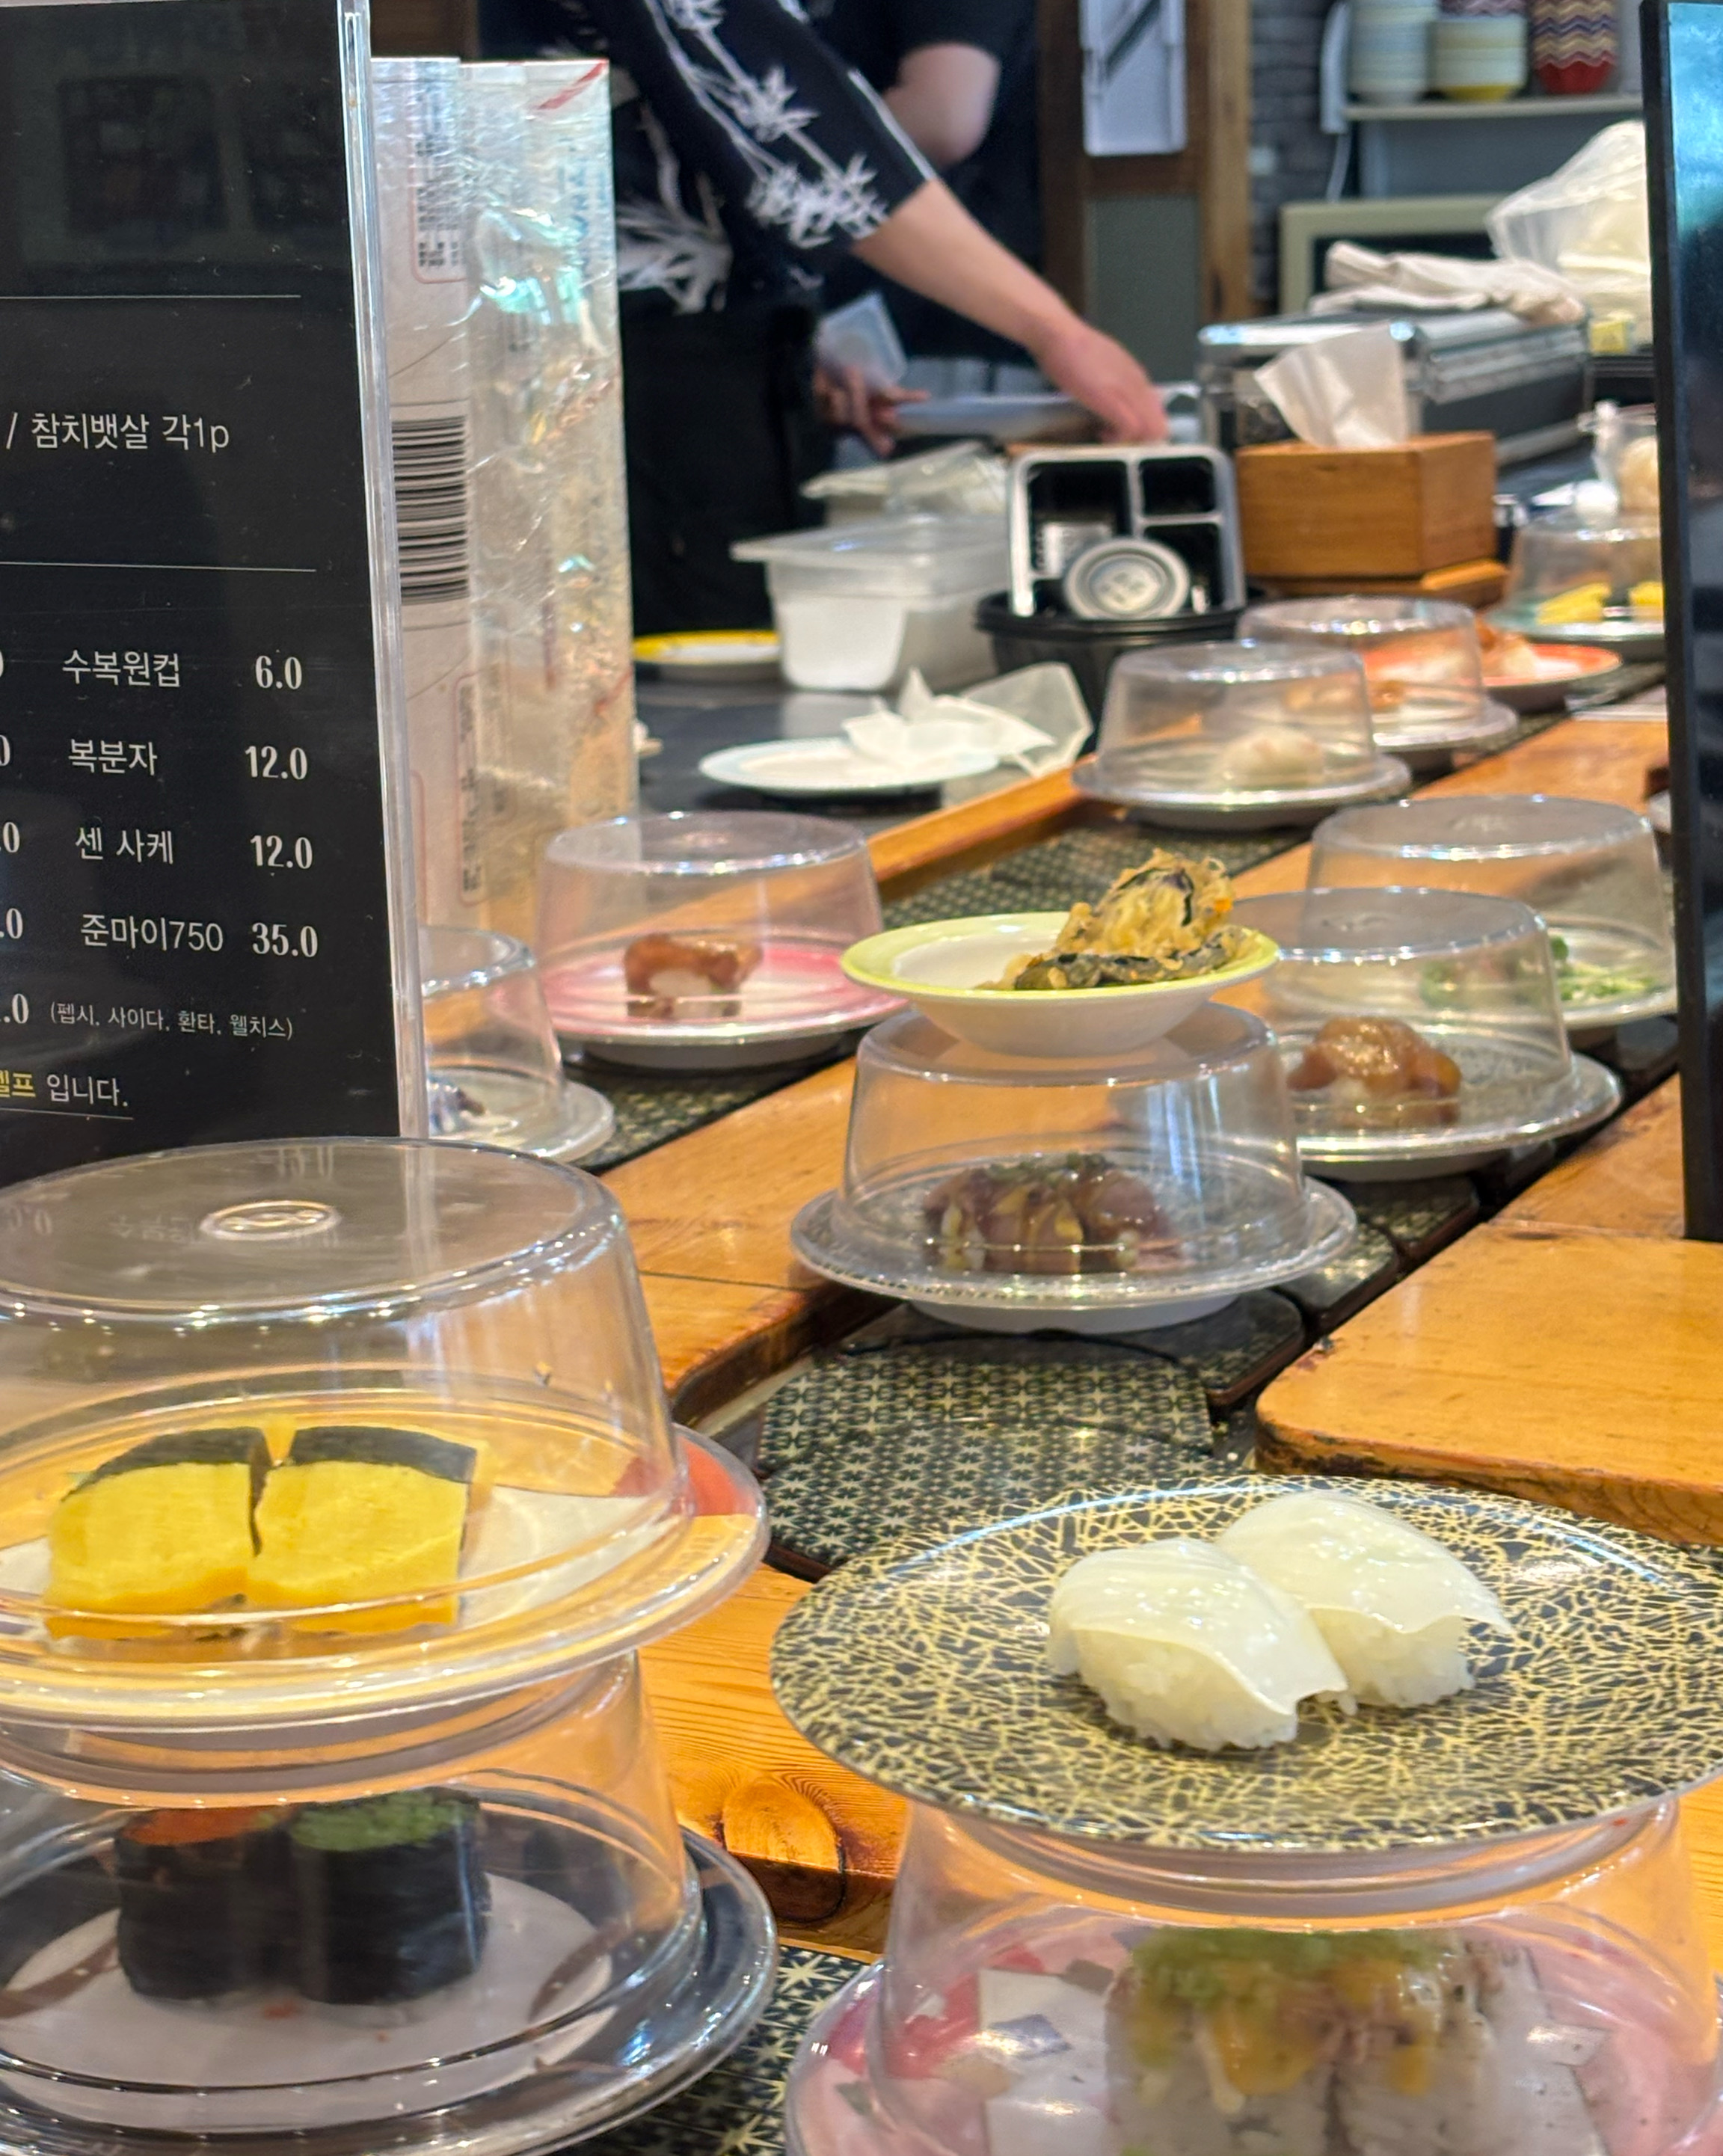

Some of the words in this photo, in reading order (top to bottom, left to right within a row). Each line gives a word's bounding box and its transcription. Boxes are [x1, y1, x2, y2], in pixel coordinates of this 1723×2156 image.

[6, 412, 18, 449] /
[31, 413, 150, 449] 참치뱃살
[162, 414, 230, 453] 각1p
[62, 649, 179, 687] 수복원컵
[255, 655, 302, 690] 6.0
[68, 739, 158, 776] 복분자
[245, 746, 307, 780] 12.0
[75, 827, 103, 860] 센
[116, 829, 173, 864] 사케
[250, 835, 313, 869] 12.0
[81, 914, 224, 951] 준마이750
[252, 922, 318, 957] 35.0
[230, 1014, 292, 1040] 웰치스)
[46, 1074, 128, 1107] 입니다.
